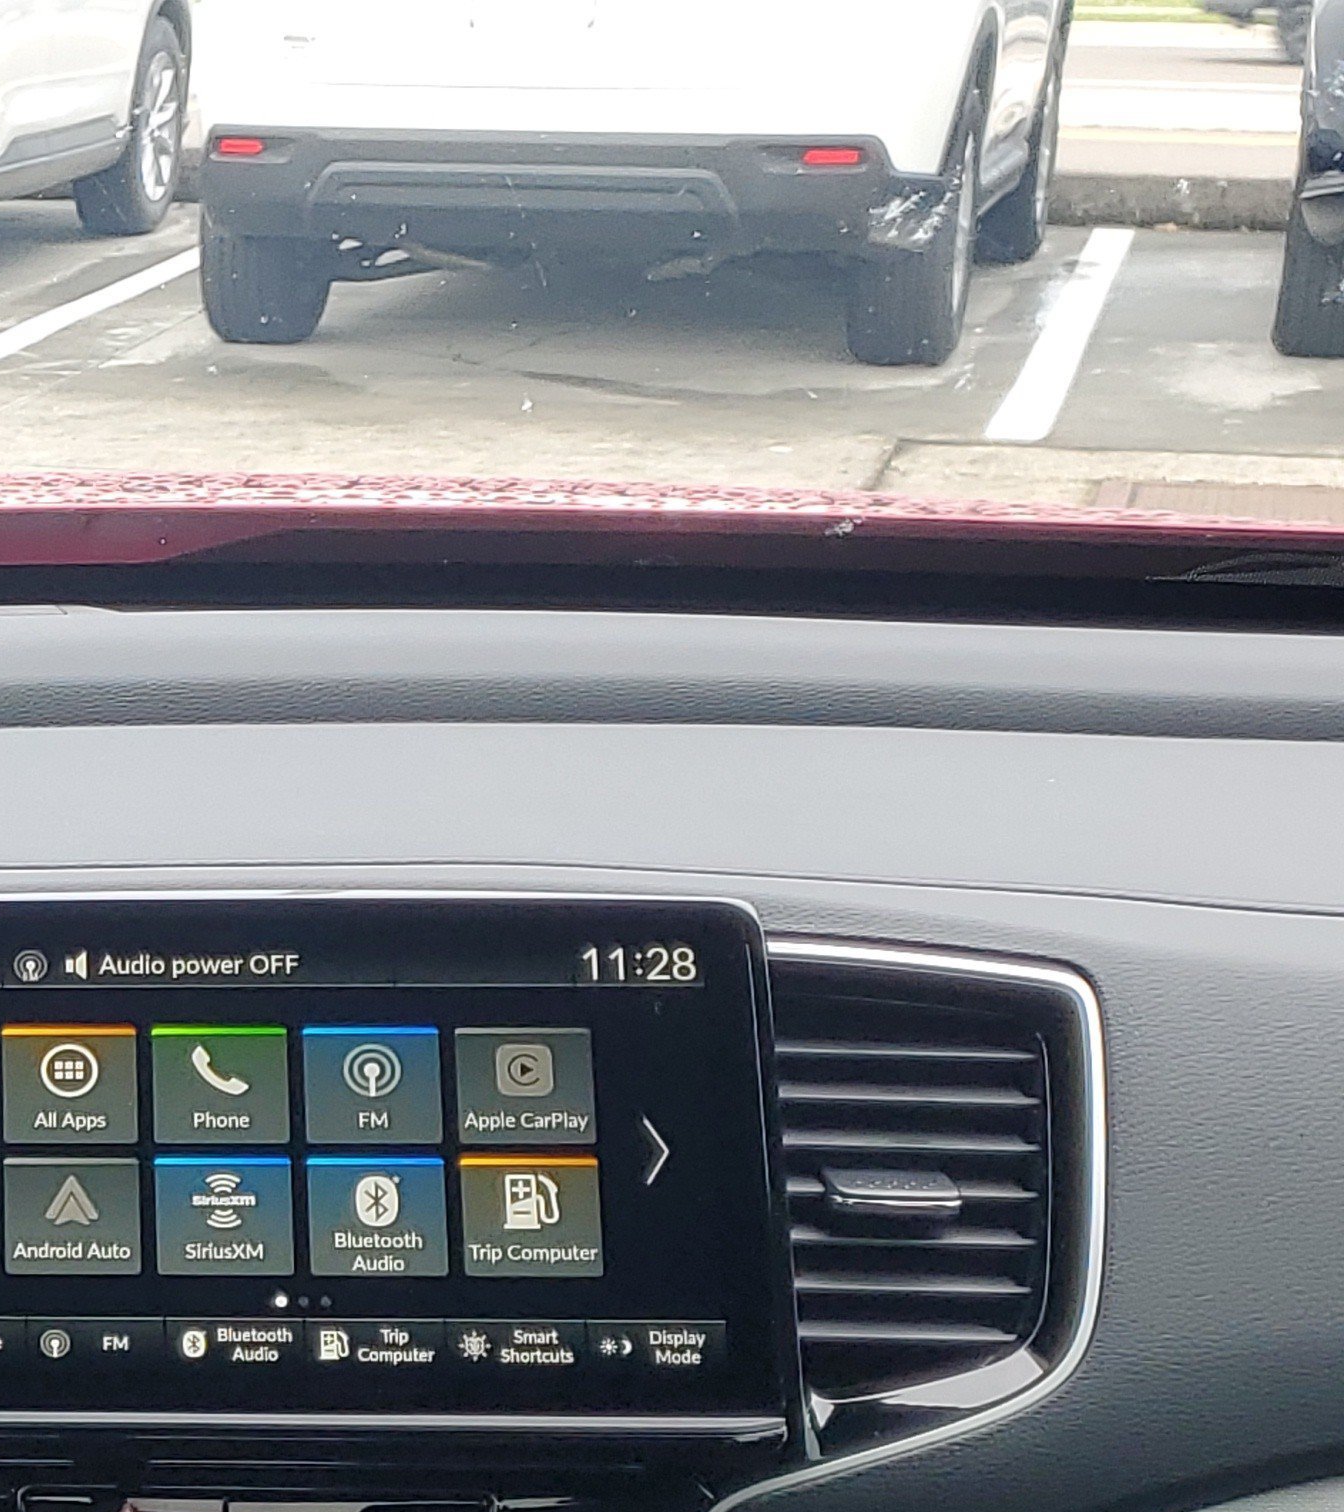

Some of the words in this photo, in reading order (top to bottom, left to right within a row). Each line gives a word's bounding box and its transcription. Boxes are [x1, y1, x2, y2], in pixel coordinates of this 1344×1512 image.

[98, 954, 165, 975] Audio
[172, 957, 243, 978] power
[249, 954, 299, 974] OFF
[582, 947, 697, 981] 11:28
[34, 1111, 57, 1128] All
[62, 1112, 107, 1131] Apps
[192, 1111, 250, 1128] Phone
[358, 1112, 389, 1128] FM
[464, 1111, 517, 1131] Apple
[520, 1111, 589, 1131] CarPlay
[333, 1232, 423, 1249] Bluetooth
[13, 1242, 82, 1260] Android
[88, 1243, 131, 1260] Auto
[185, 1243, 264, 1260] SiriusXM
[468, 1244, 503, 1264] Trip
[507, 1244, 599, 1264] Computer
[352, 1255, 405, 1273] Audio
[102, 1336, 130, 1352] FM
[216, 1327, 293, 1345] Bluetooth
[379, 1329, 410, 1348] Trip
[513, 1329, 559, 1345] Smart
[649, 1330, 707, 1348] Display
[232, 1346, 280, 1363] Audio
[357, 1346, 436, 1365] Computer
[501, 1346, 575, 1364] Shortcuts
[655, 1348, 702, 1364] Mode
